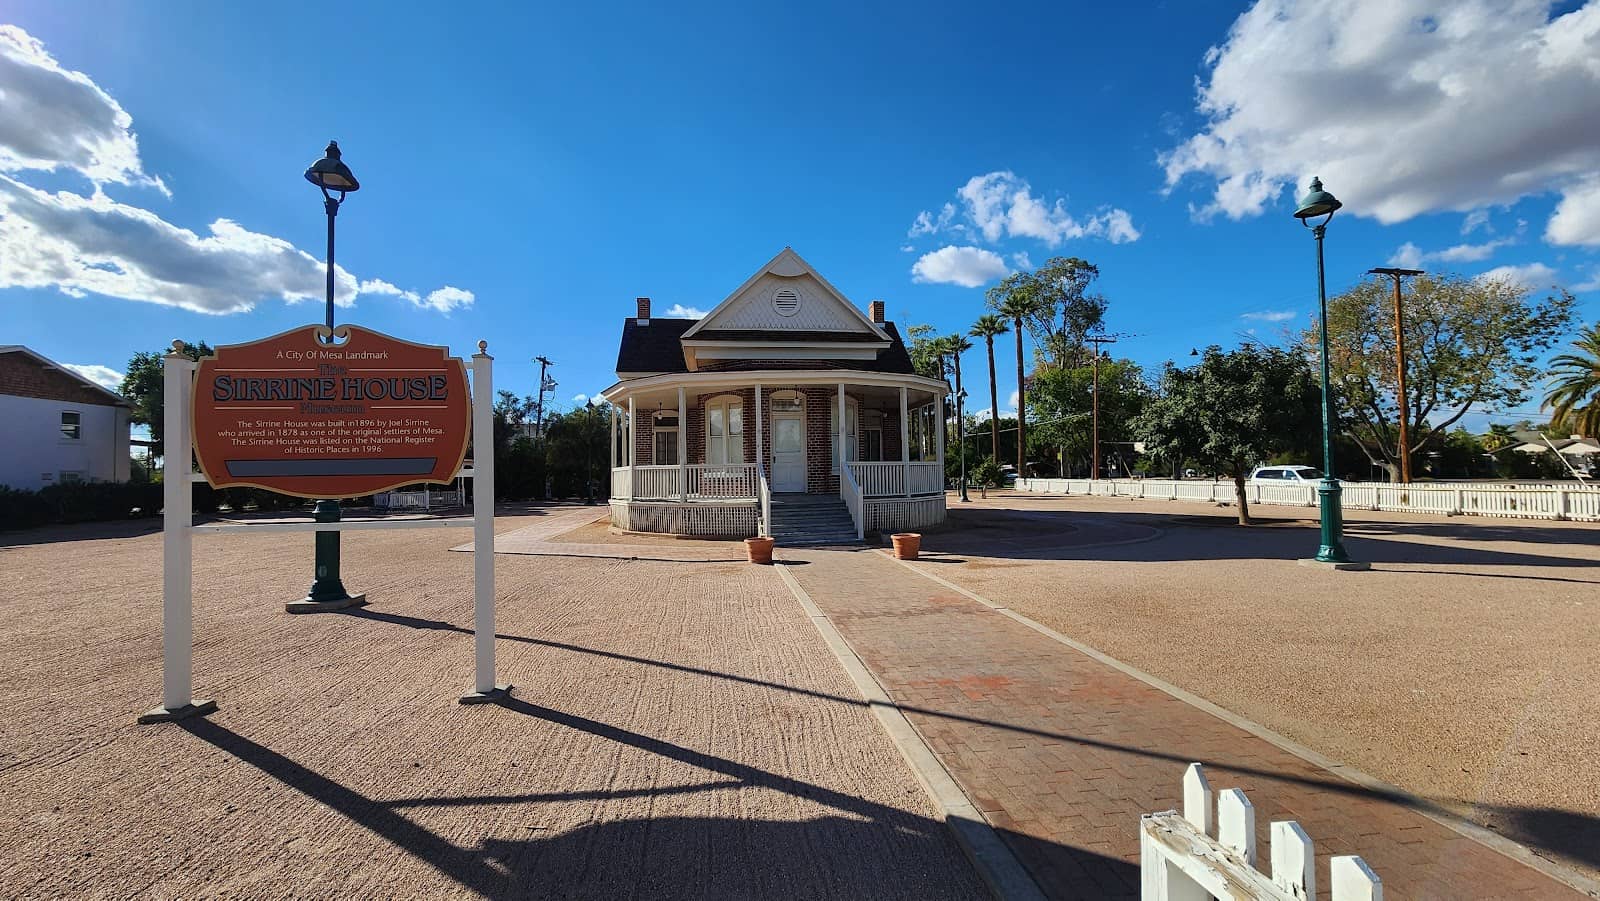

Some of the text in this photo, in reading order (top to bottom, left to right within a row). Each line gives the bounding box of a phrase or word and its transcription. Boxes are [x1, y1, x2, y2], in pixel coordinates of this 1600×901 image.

[276, 350, 388, 361] A City Of Mesa Landmark
[319, 363, 346, 376] The
[214, 375, 448, 400] SIRRINE HOUSE
[238, 420, 252, 428] The
[377, 420, 387, 428] by
[389, 419, 402, 427] Joel
[352, 428, 381, 437] original
[404, 436, 436, 445] Register
